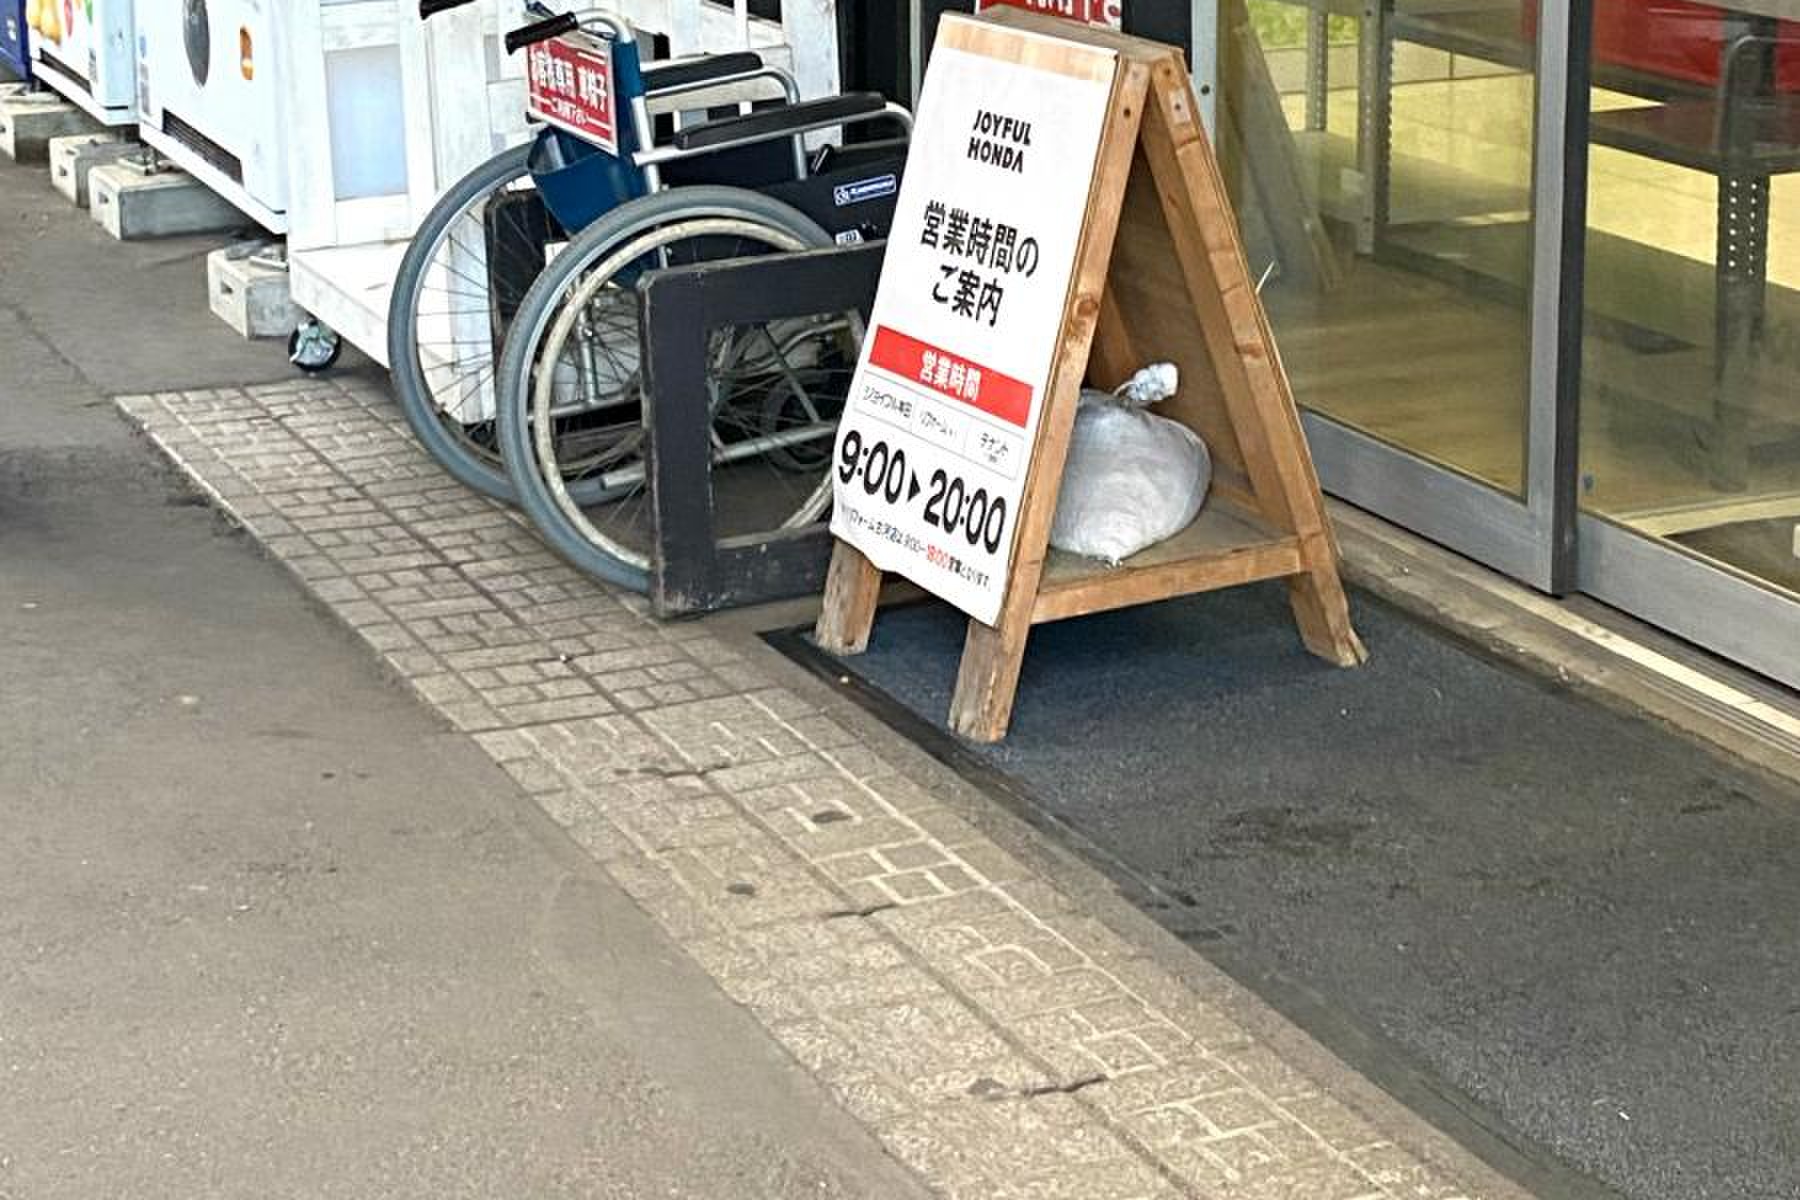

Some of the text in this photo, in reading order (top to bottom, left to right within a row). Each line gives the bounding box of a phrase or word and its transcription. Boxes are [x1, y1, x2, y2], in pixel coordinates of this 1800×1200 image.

[966, 137, 1024, 174] HONDA
[973, 109, 1032, 146] JOYFUL
[920, 199, 1040, 279] 営業時間の
[931, 264, 1004, 328] ご案内
[919, 350, 982, 401] 営業時間
[838, 429, 906, 505] 9:00
[922, 468, 1007, 555] 20:00
